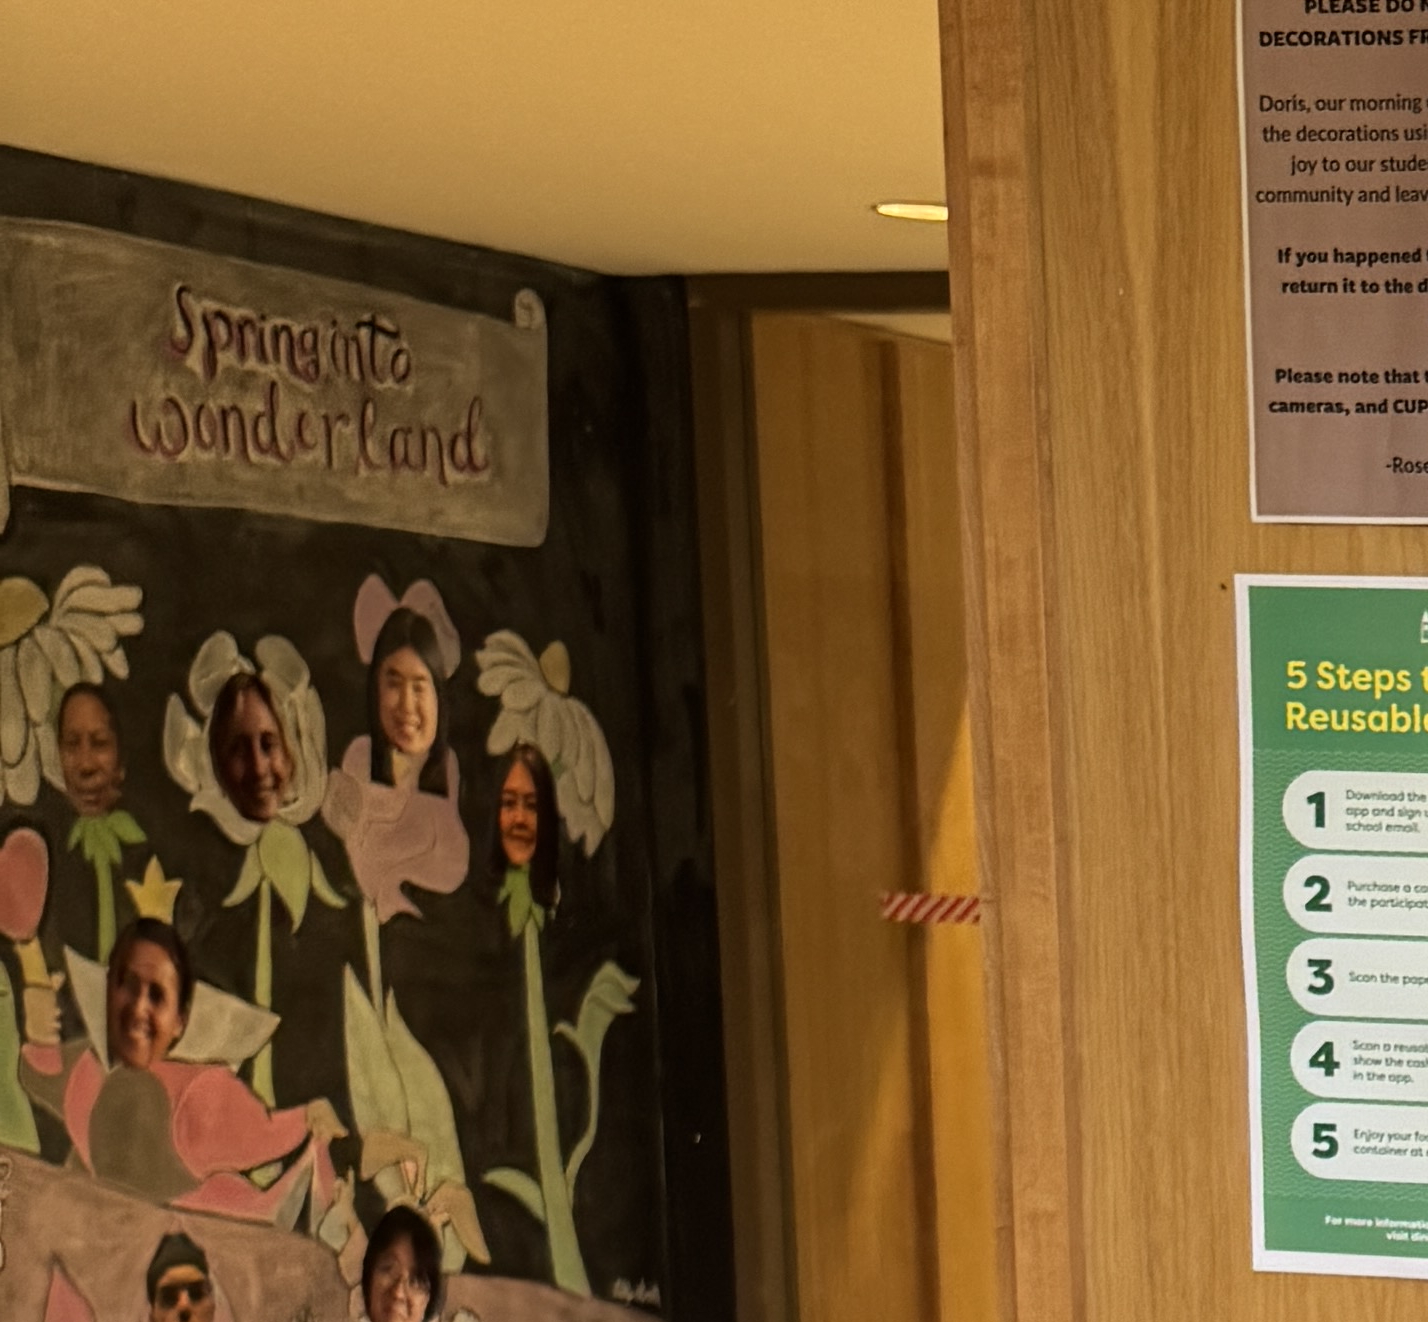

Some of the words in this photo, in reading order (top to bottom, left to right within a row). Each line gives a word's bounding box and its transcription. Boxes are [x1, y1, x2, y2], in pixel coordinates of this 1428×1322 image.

[1259, 29, 1405, 47] DECORATIONS
[1259, 94, 1312, 113] Doris,
[1313, 98, 1347, 112] our
[1349, 93, 1423, 114] morning
[1262, 124, 1292, 143] the
[1295, 124, 1400, 143] decorations
[1290, 155, 1318, 177] joy
[1321, 156, 1341, 173] to
[1344, 159, 1377, 173] our
[1255, 185, 1354, 207] community
[1357, 185, 1391, 203] and
[1277, 247, 1292, 264] If
[1295, 251, 1329, 268] you
[1332, 247, 1422, 268] happened
[1281, 280, 1339, 294] return
[1342, 276, 1357, 294] it
[1359, 279, 1381, 294] to
[1383, 278, 1414, 294] the
[172, 284, 320, 384] Spring
[329, 313, 412, 385] into
[1274, 368, 1334, 384] Please
[1337, 370, 1380, 384] note
[1383, 368, 1421, 384] that
[1268, 401, 1351, 416] cameras,
[1354, 398, 1389, 414] and
[1286, 660, 1308, 690] 5
[1316, 661, 1412, 699] Steps
[1306, 792, 1326, 827] 1
[1304, 875, 1333, 912] 2
[1306, 959, 1334, 995] 3
[1348, 971, 1378, 983] Scan
[1379, 972, 1400, 985] the
[1308, 1041, 1340, 1077] 4
[1312, 1123, 1338, 1159] 5
